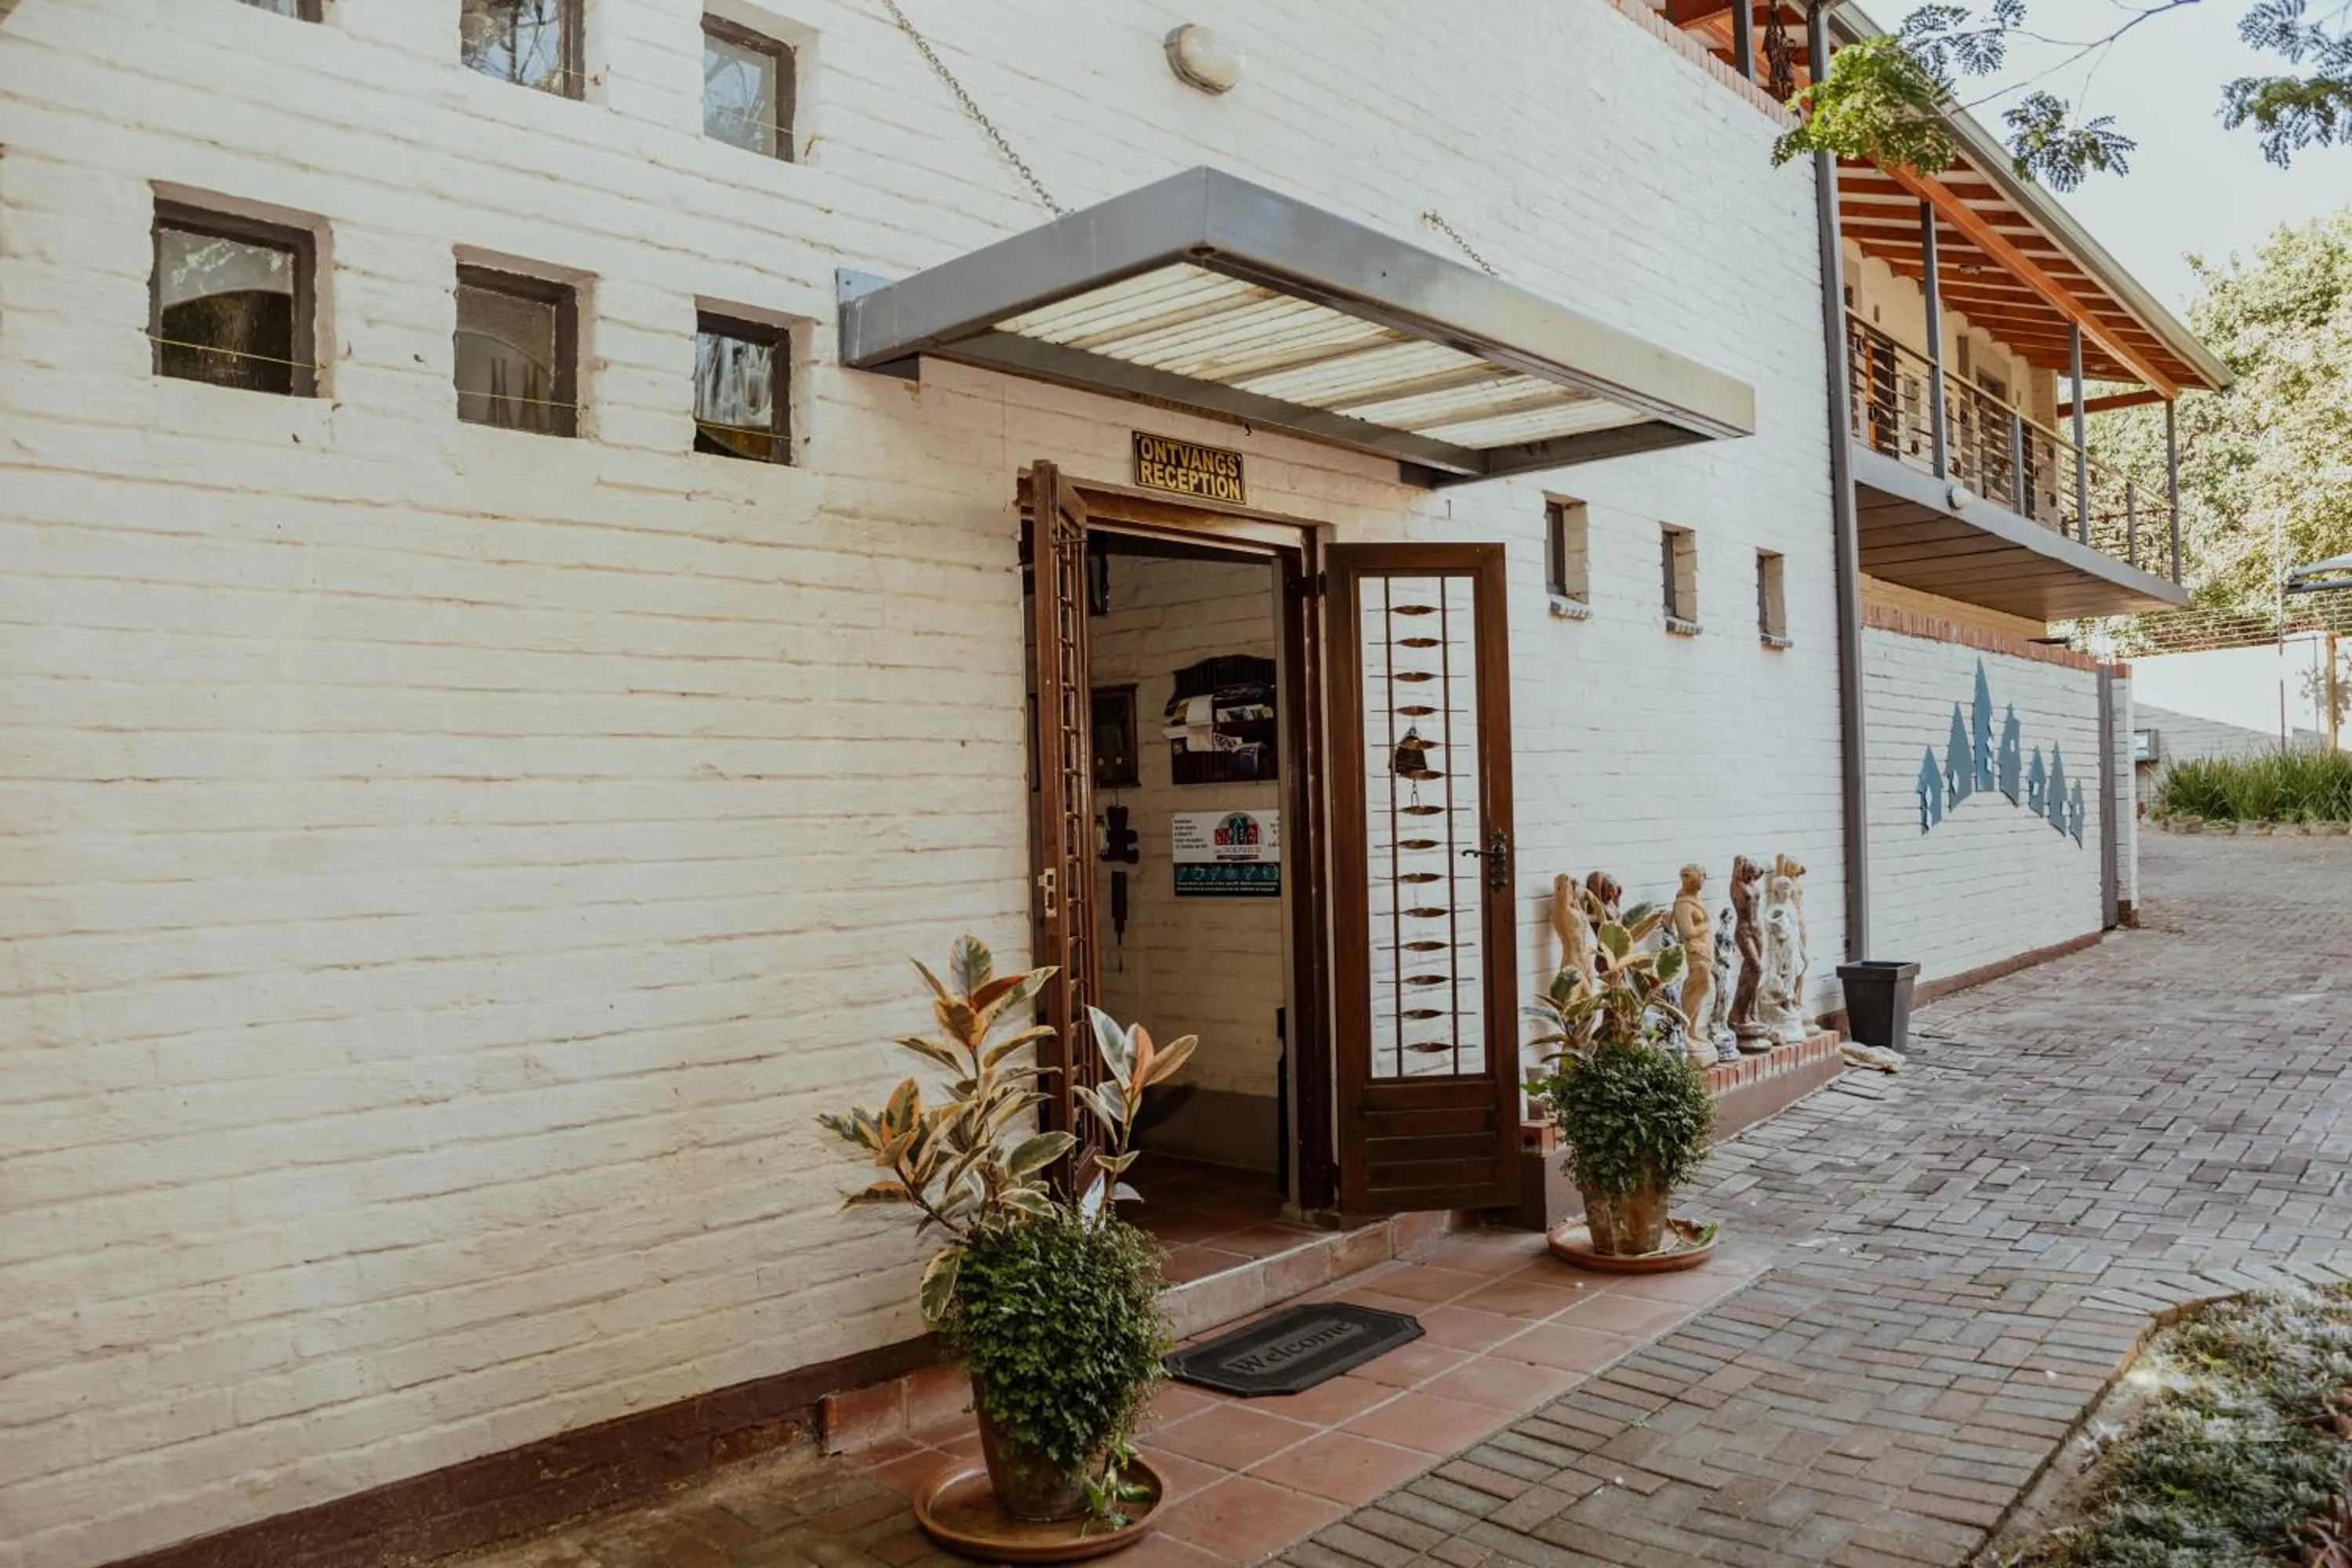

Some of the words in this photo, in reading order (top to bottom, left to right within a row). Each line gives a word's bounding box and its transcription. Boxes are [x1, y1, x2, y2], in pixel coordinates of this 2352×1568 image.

[1141, 437, 1237, 477] ONTVANGS
[1141, 460, 1240, 499] RECEPTION
[1227, 1319, 1352, 1372] Welcome
